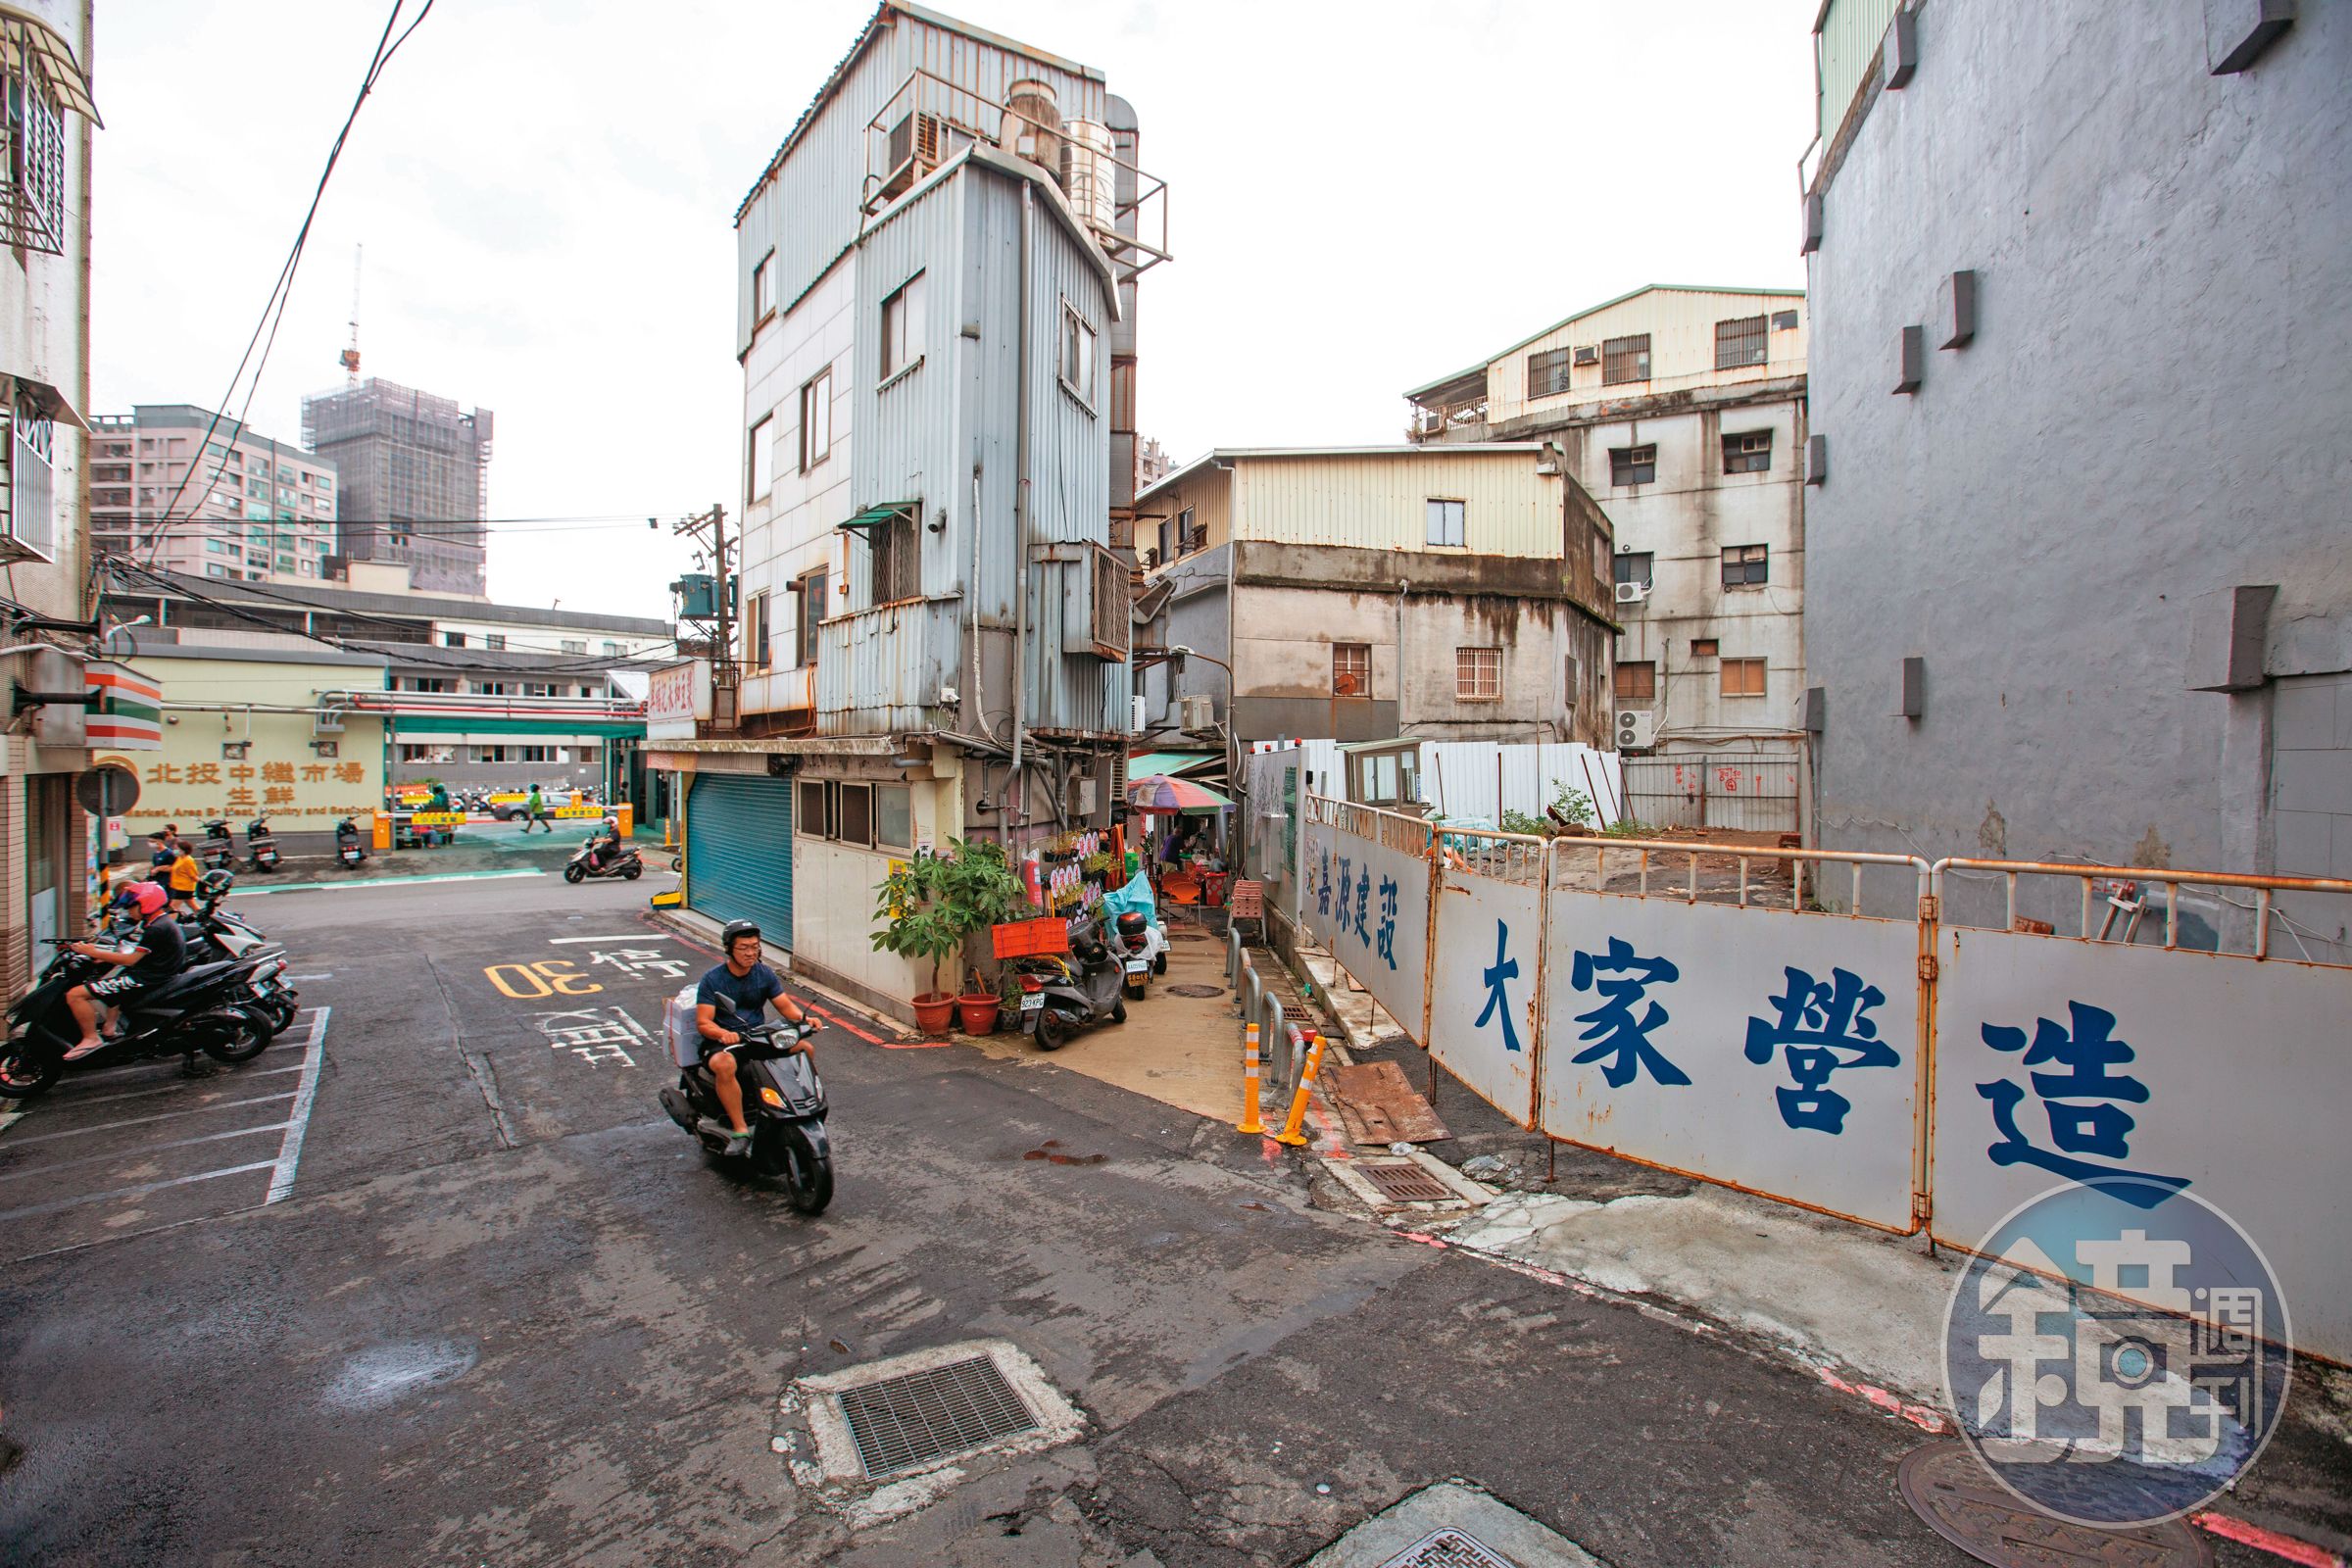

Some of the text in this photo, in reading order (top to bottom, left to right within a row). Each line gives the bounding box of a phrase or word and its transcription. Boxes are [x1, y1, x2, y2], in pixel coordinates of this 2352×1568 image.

[147, 761, 366, 785] 北投中繼市場
[126, 808, 170, 818] arket,
[172, 808, 203, 817] Area
[306, 806, 326, 815] and
[227, 786, 296, 806] 生鮮
[1317, 847, 1398, 971] 嘉源建設
[483, 959, 604, 999] 30
[1473, 917, 2194, 1211] 大家營造
